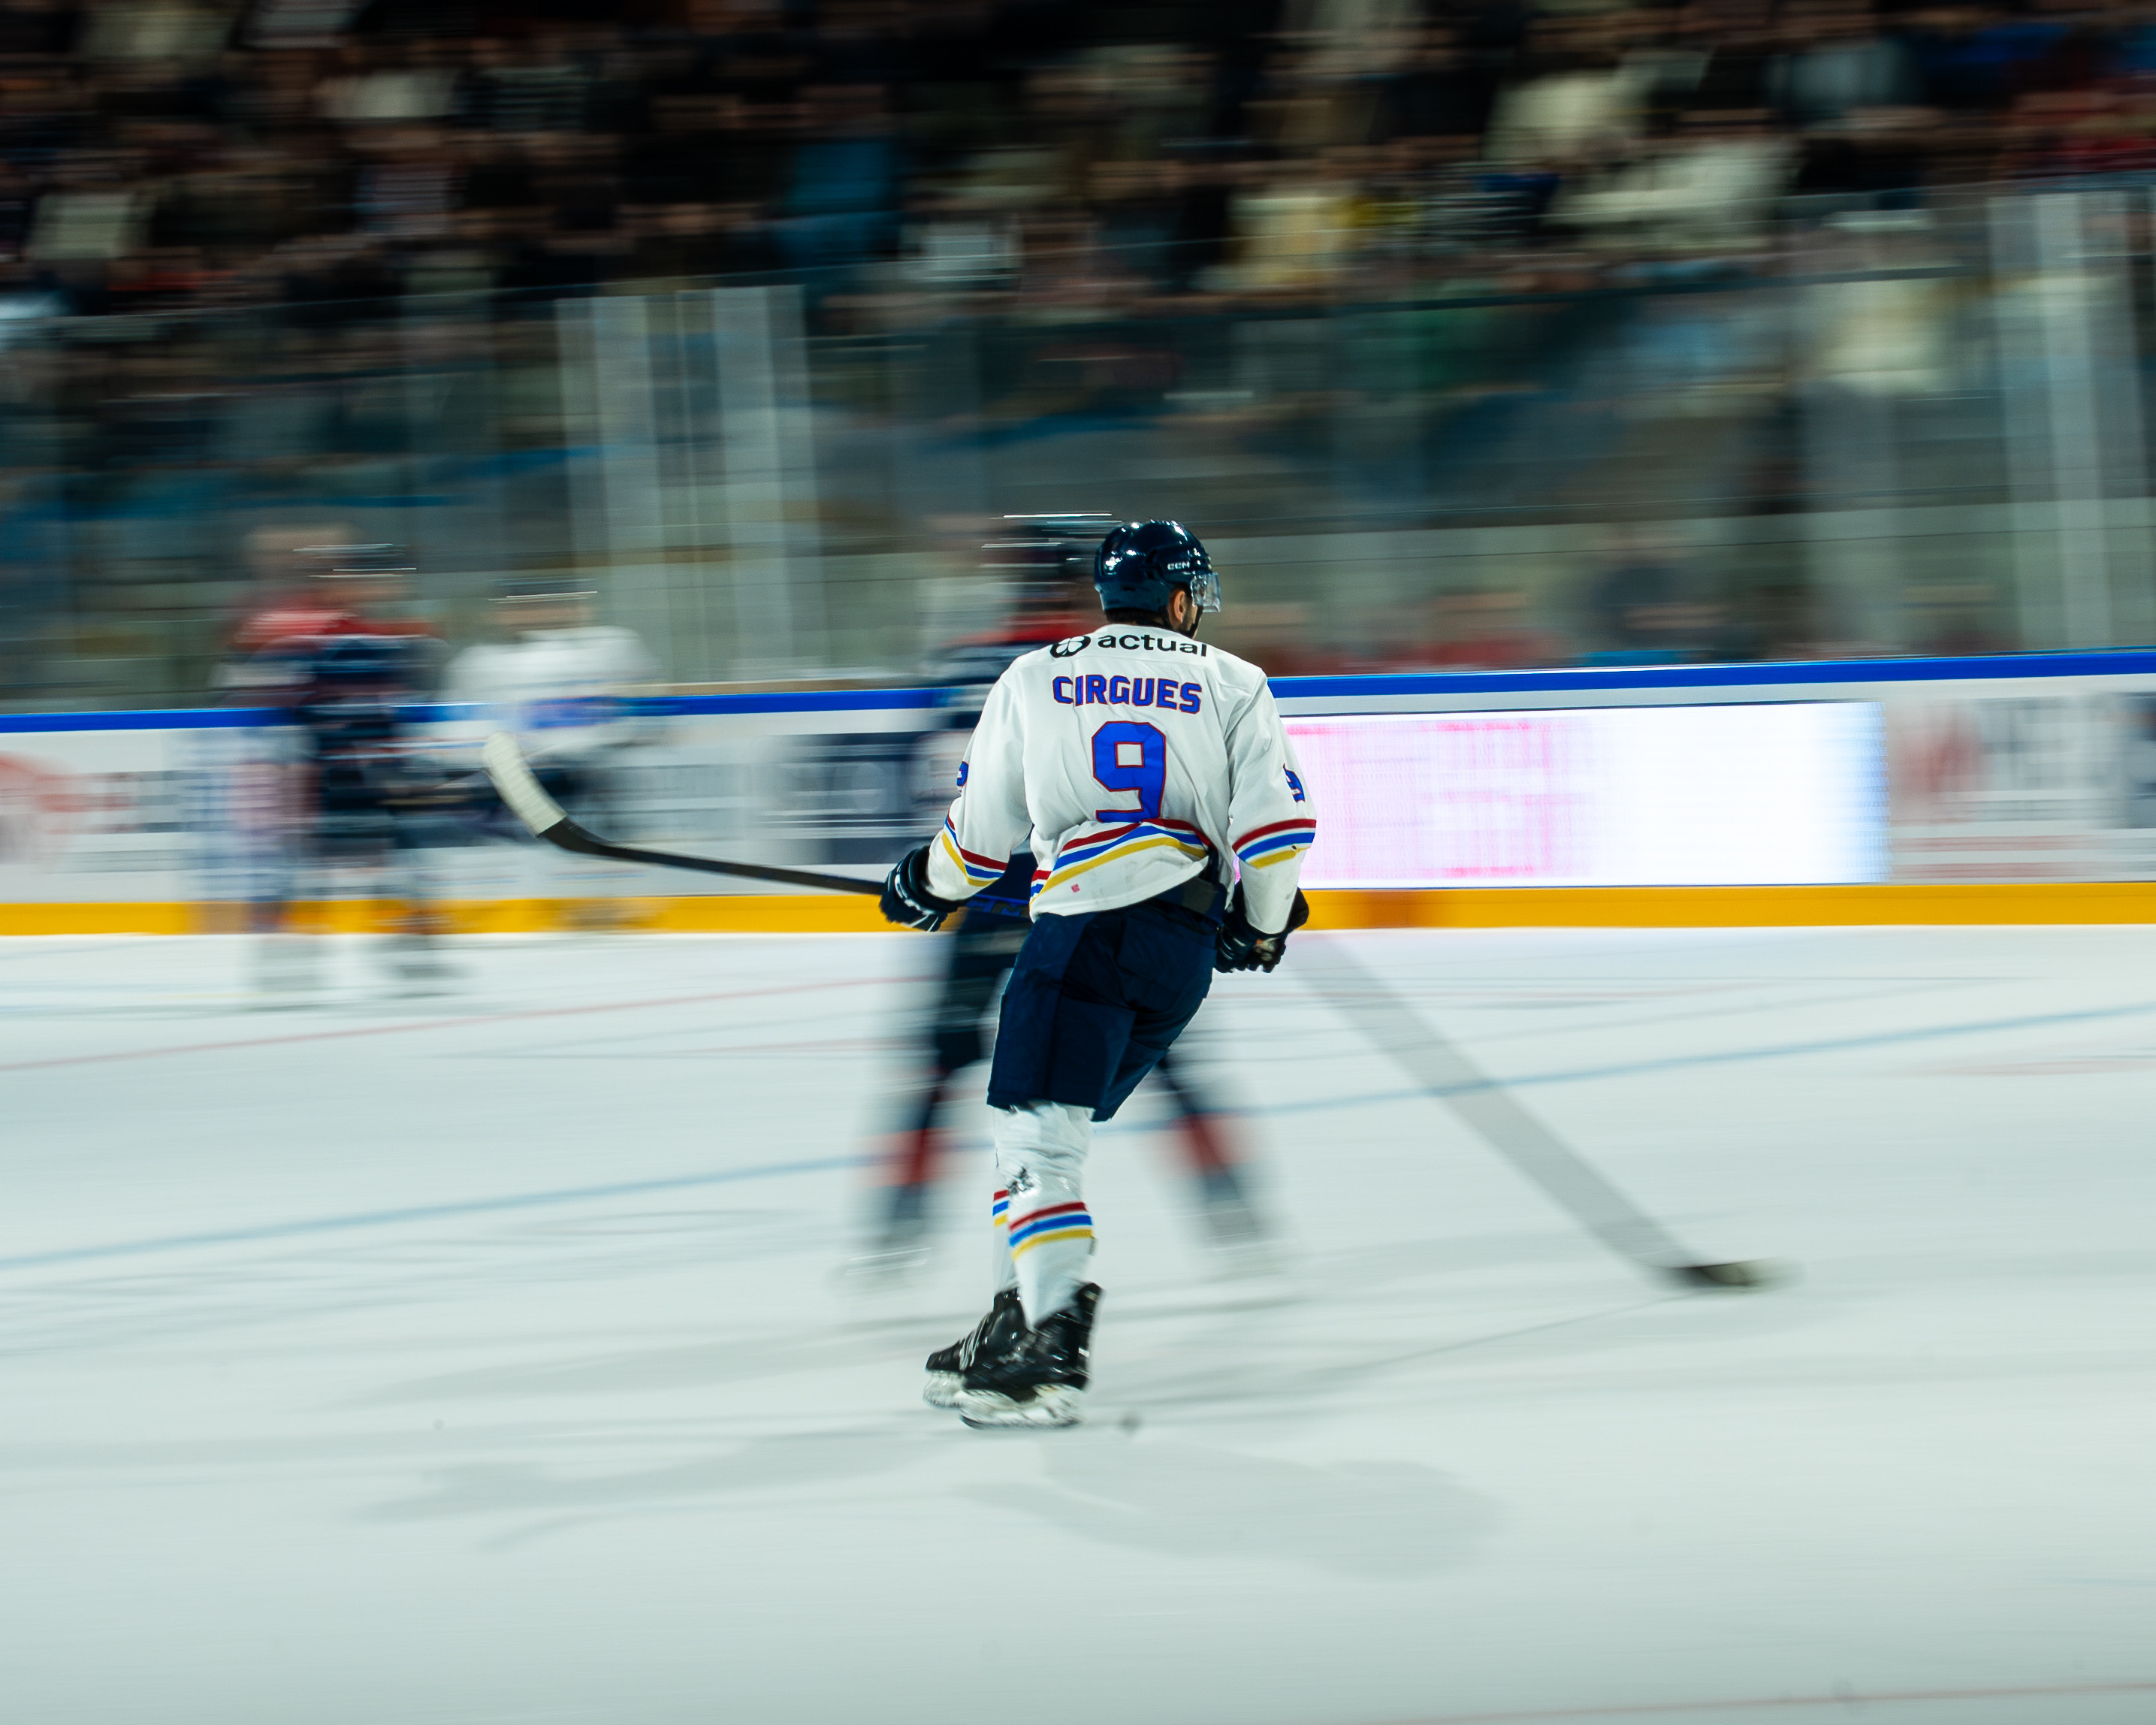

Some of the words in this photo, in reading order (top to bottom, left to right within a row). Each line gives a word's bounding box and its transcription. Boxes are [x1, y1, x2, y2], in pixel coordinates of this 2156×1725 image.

[1167, 561, 1190, 570] CCM
[1098, 634, 1207, 657] actual
[1052, 674, 1202, 714] CIRGUES
[1092, 720, 1166, 823] 9
